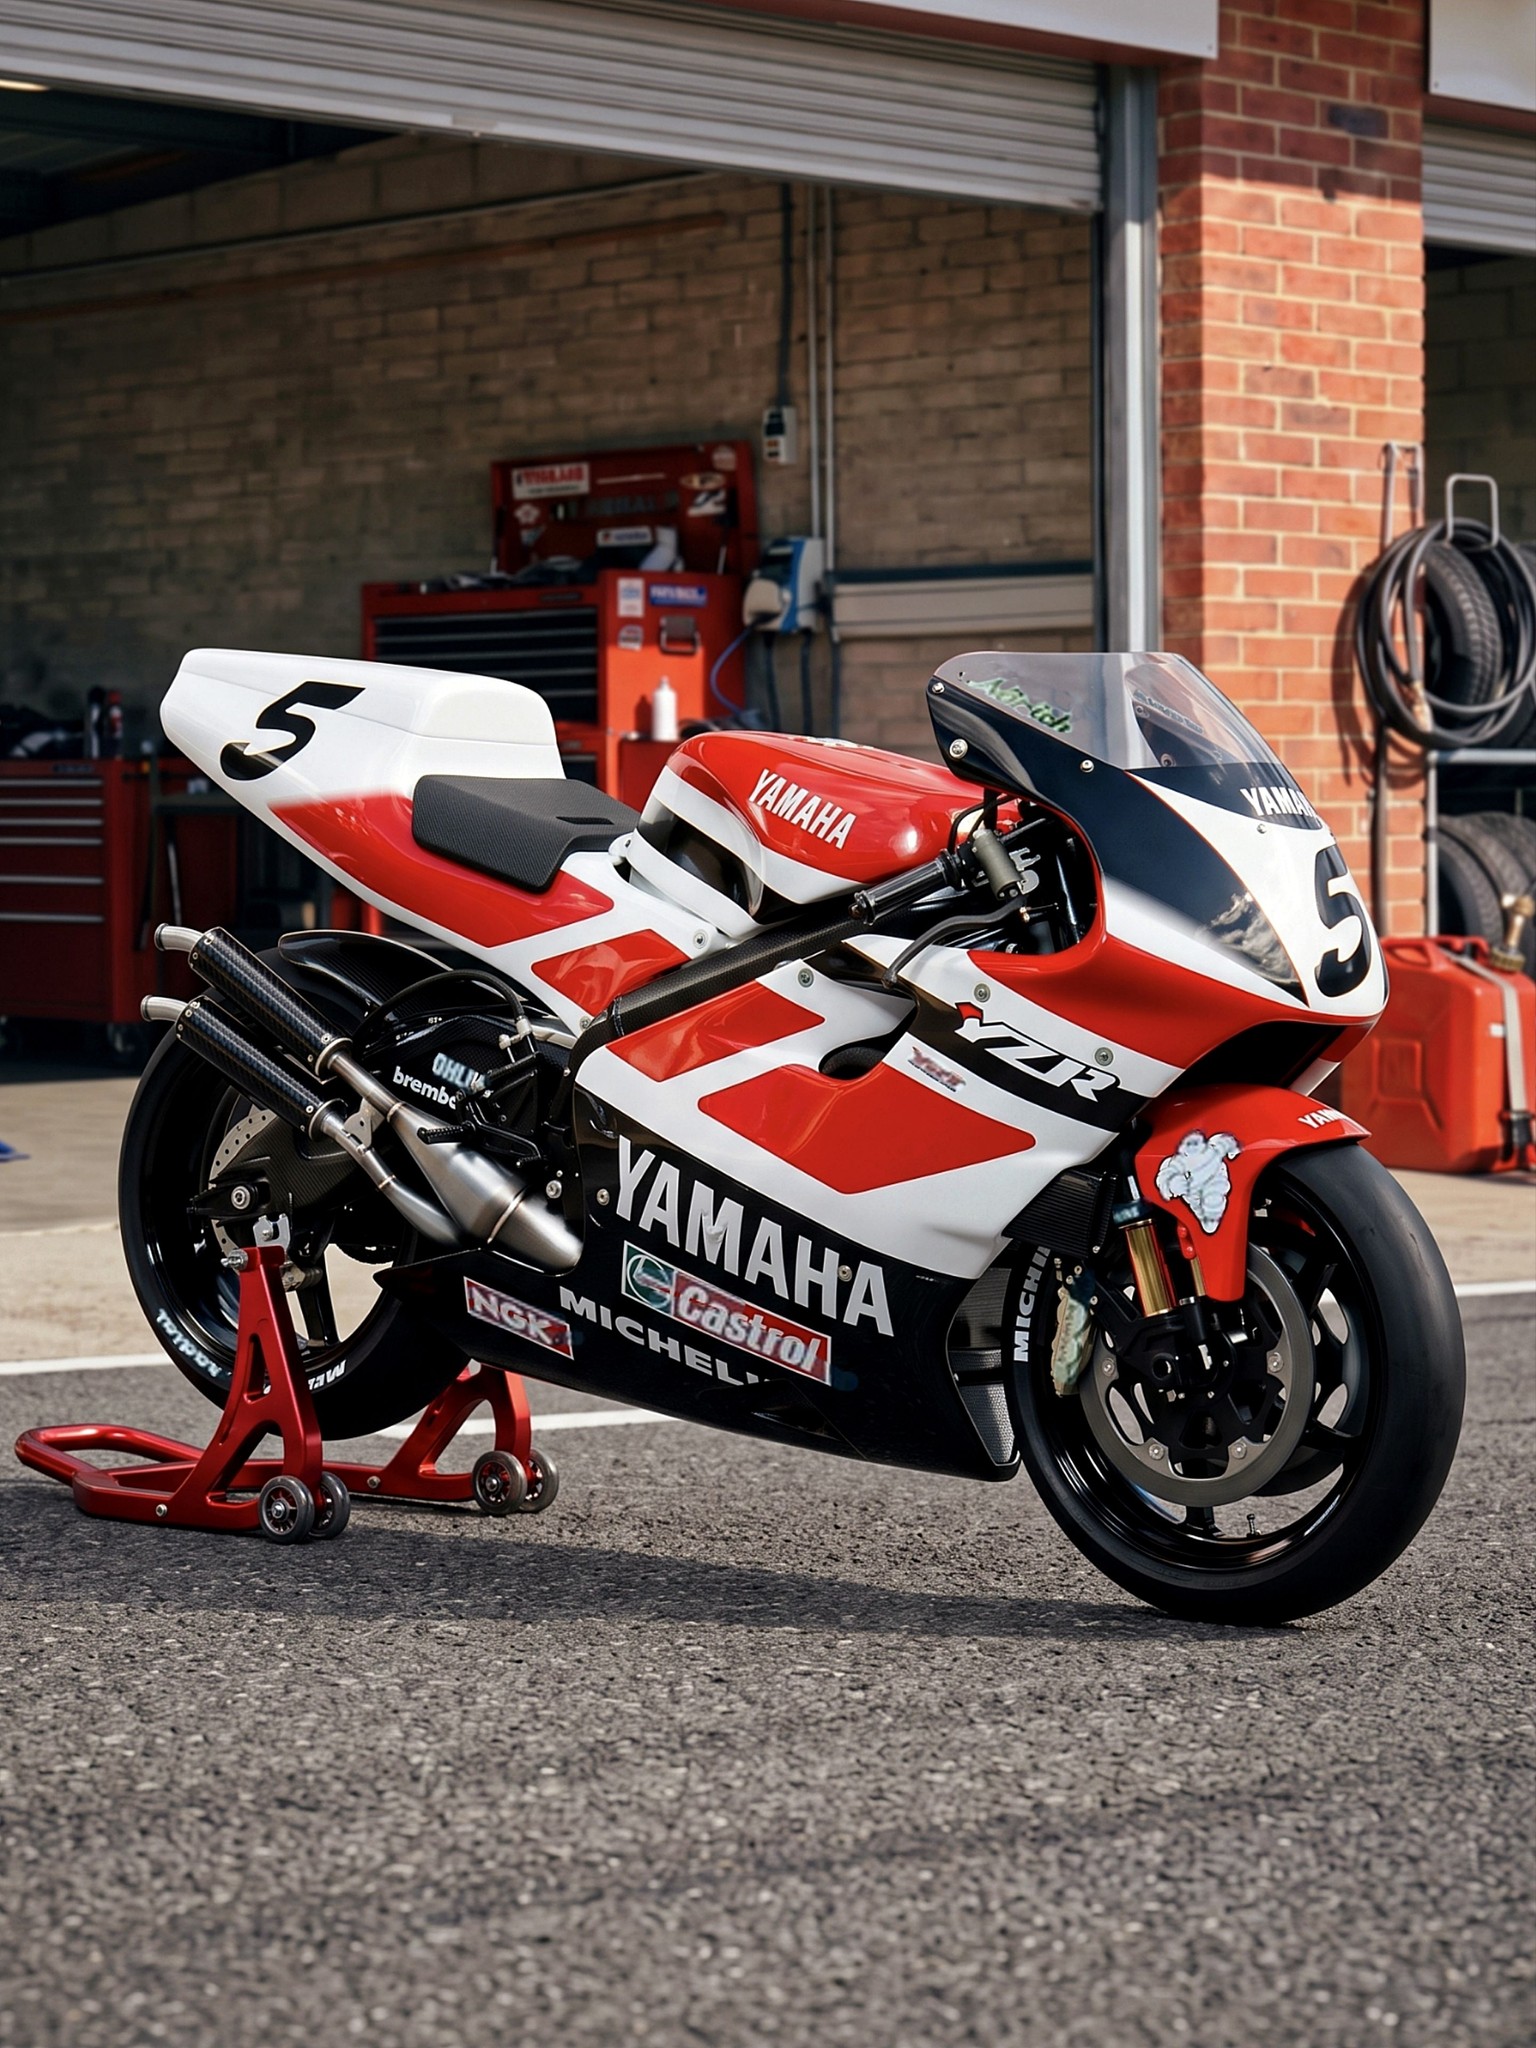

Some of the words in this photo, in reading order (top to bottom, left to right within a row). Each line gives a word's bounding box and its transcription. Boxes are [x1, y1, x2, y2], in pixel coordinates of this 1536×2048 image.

[220, 681, 366, 781] 5
[748, 768, 857, 850] YAMAHA
[1315, 844, 1372, 998] 5
[954, 1002, 1116, 1102] YZR
[616, 1134, 894, 1337] YAMAHA
[471, 1286, 553, 1345] NGK
[559, 1286, 770, 1386] MICHEL
[676, 1285, 821, 1373] Castrol
